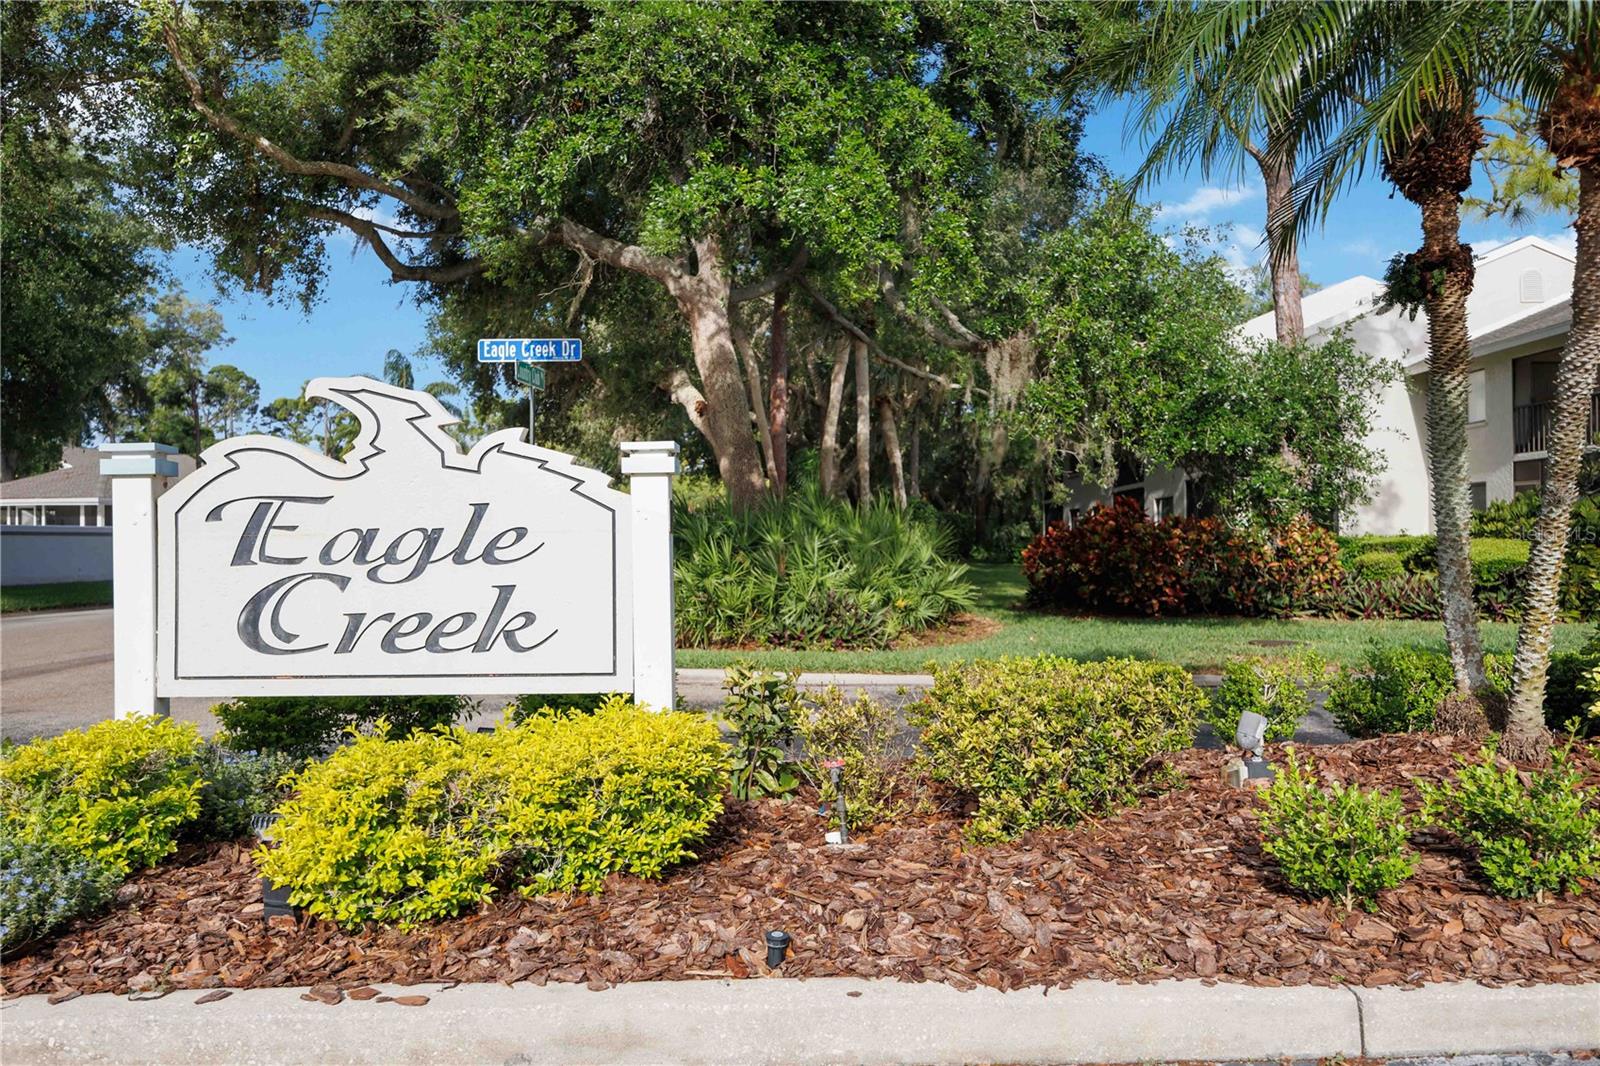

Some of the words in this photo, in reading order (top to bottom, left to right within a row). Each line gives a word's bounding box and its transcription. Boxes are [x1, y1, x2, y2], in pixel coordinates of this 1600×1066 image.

[484, 341, 516, 360] Eagle
[521, 340, 557, 357] Creek
[562, 340, 577, 357] Dr
[205, 495, 545, 584] Eagle
[237, 572, 558, 656] Creek
